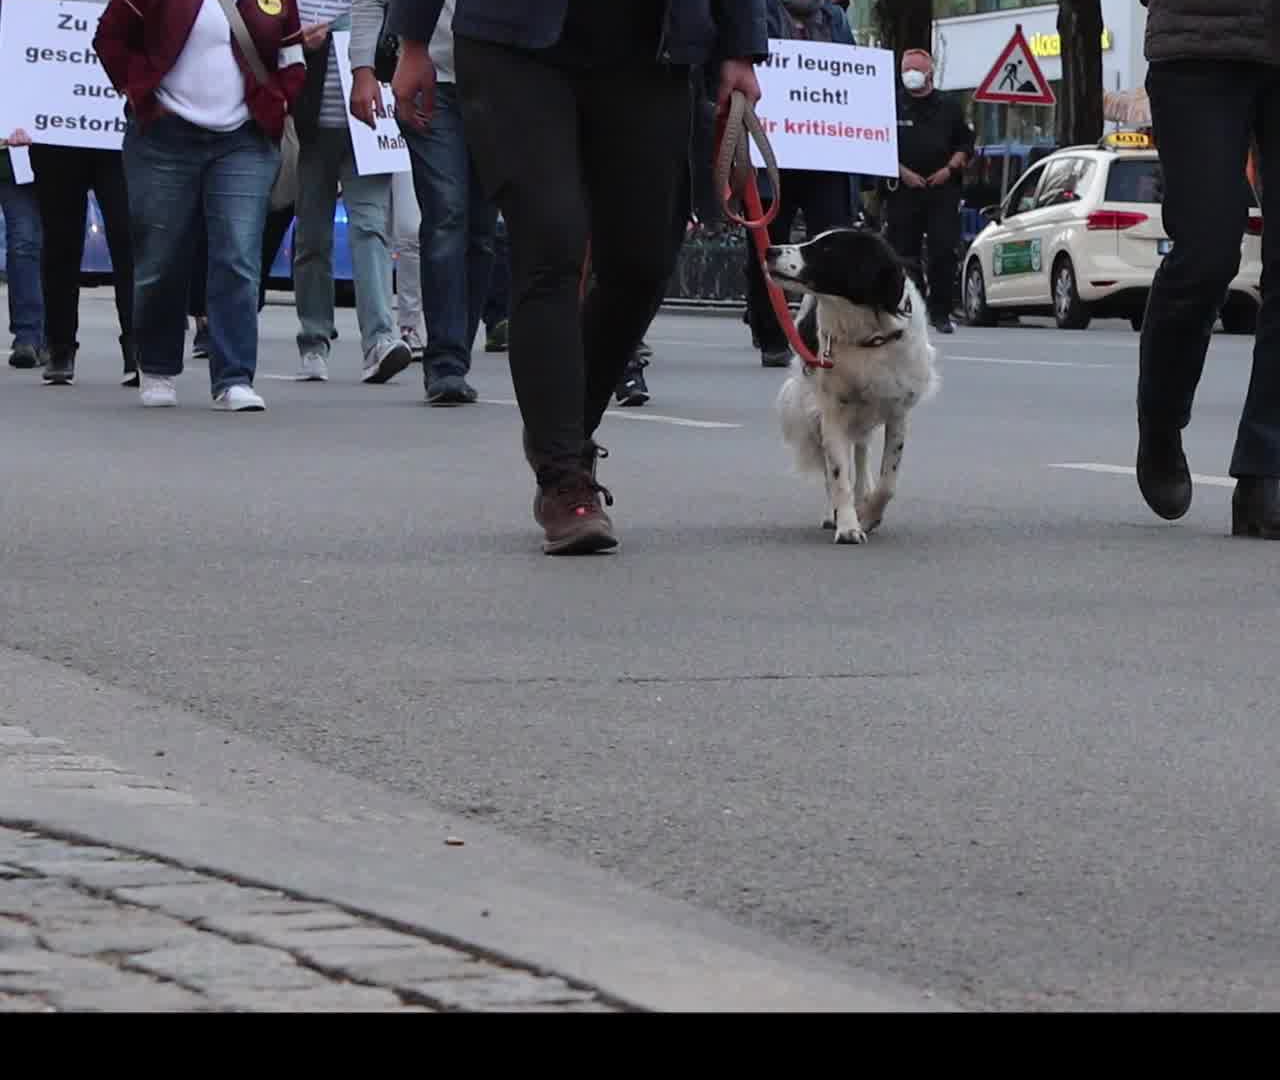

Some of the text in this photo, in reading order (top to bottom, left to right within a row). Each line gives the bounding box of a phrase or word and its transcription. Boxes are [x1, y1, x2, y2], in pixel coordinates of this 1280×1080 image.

[57, 13, 88, 32] Zu
[25, 46, 98, 64] gesch
[797, 54, 877, 77] leugnen
[72, 83, 123, 99] auc
[789, 86, 849, 105] nicht!
[34, 113, 127, 133] gestorb
[784, 118, 890, 142] kritisieren!
